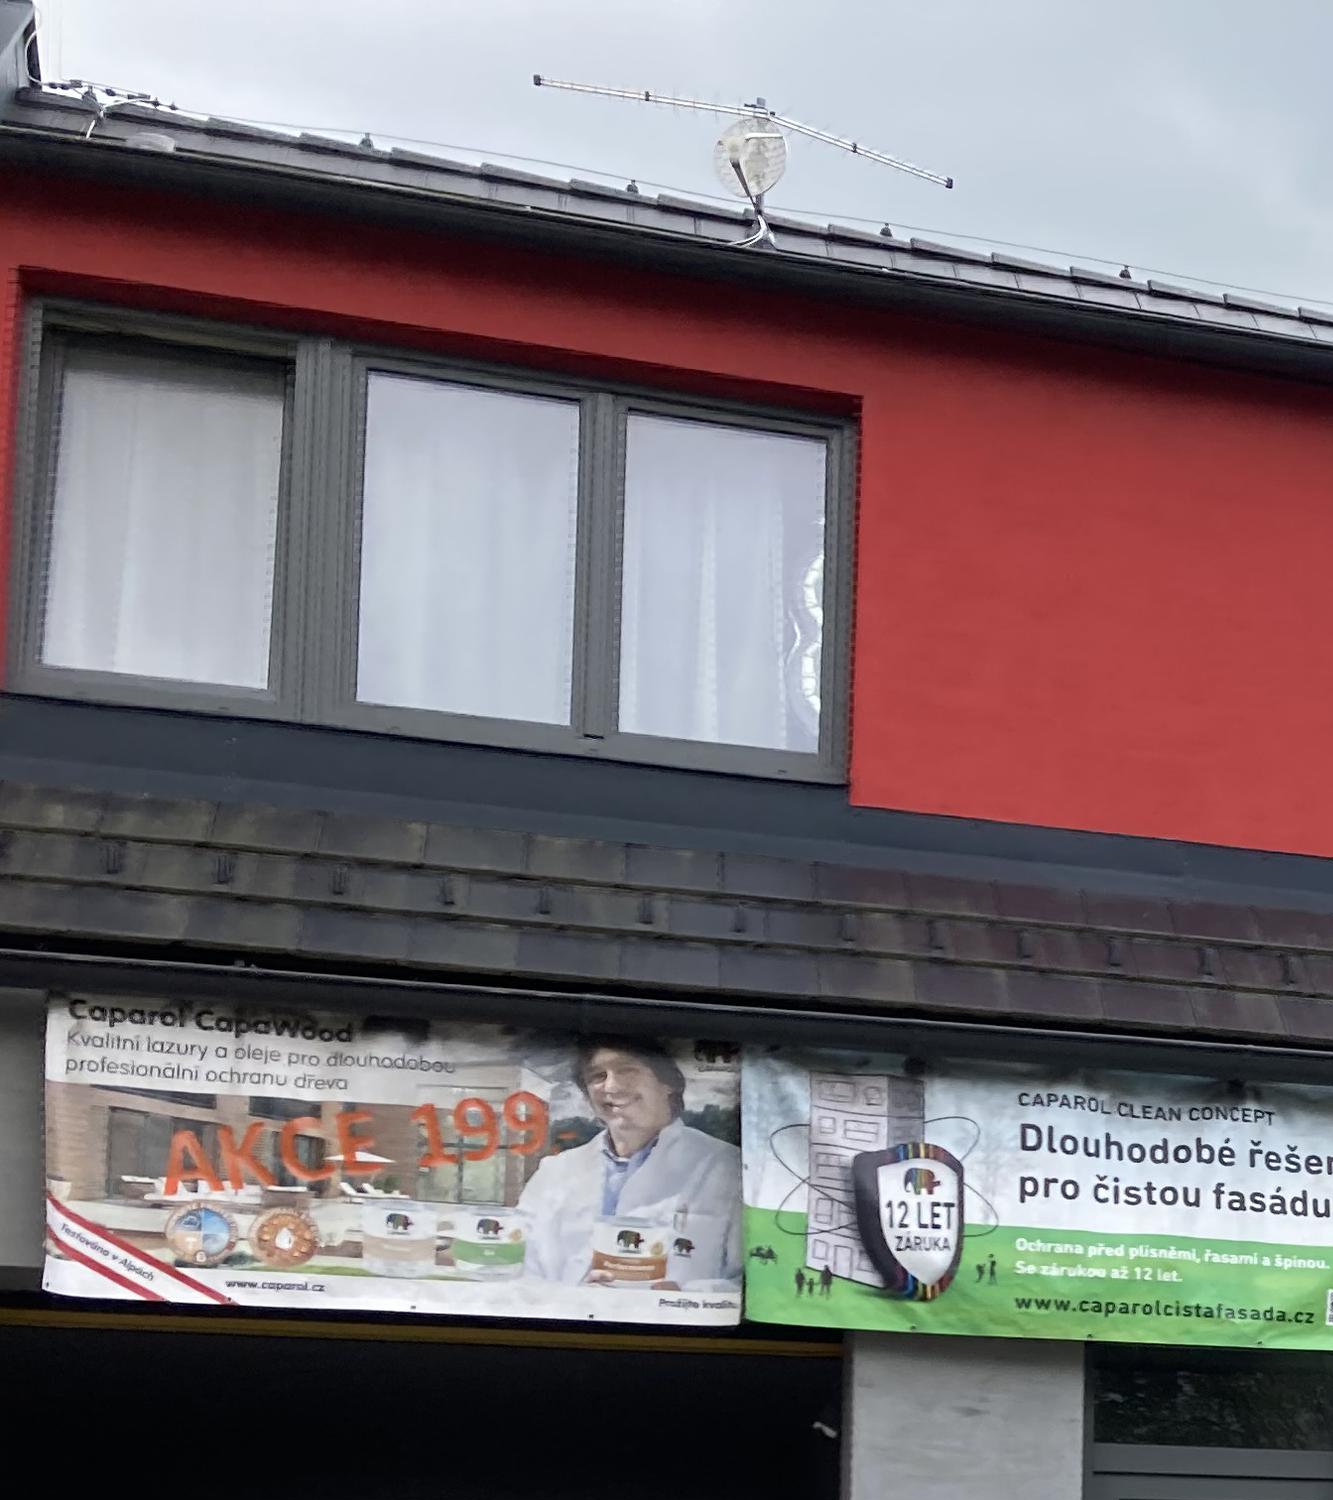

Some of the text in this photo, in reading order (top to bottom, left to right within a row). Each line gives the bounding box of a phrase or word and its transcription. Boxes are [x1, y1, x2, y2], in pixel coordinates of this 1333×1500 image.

[214, 1044, 228, 1058] a
[234, 1044, 282, 1065] oleje
[287, 1052, 320, 1070] pro
[1017, 1092, 1276, 1126] CAPAROL CLEAN CONCEPT
[163, 1108, 389, 1196] AKCE
[1020, 1122, 1236, 1168] Dlouhodobé
[1019, 1174, 1081, 1204] pro
[1092, 1174, 1201, 1209] čistou
[885, 1200, 956, 1230] 12 LET
[894, 1231, 951, 1252] ZÁRUKA
[1014, 1237, 1084, 1256] Ochrana
[1087, 1243, 1126, 1261] před
[1261, 1256, 1272, 1267] a
[1014, 1260, 1183, 1283] Se zárukou až 12 let.
[1014, 1295, 1316, 1326] www.caparolcistafasada.cz
